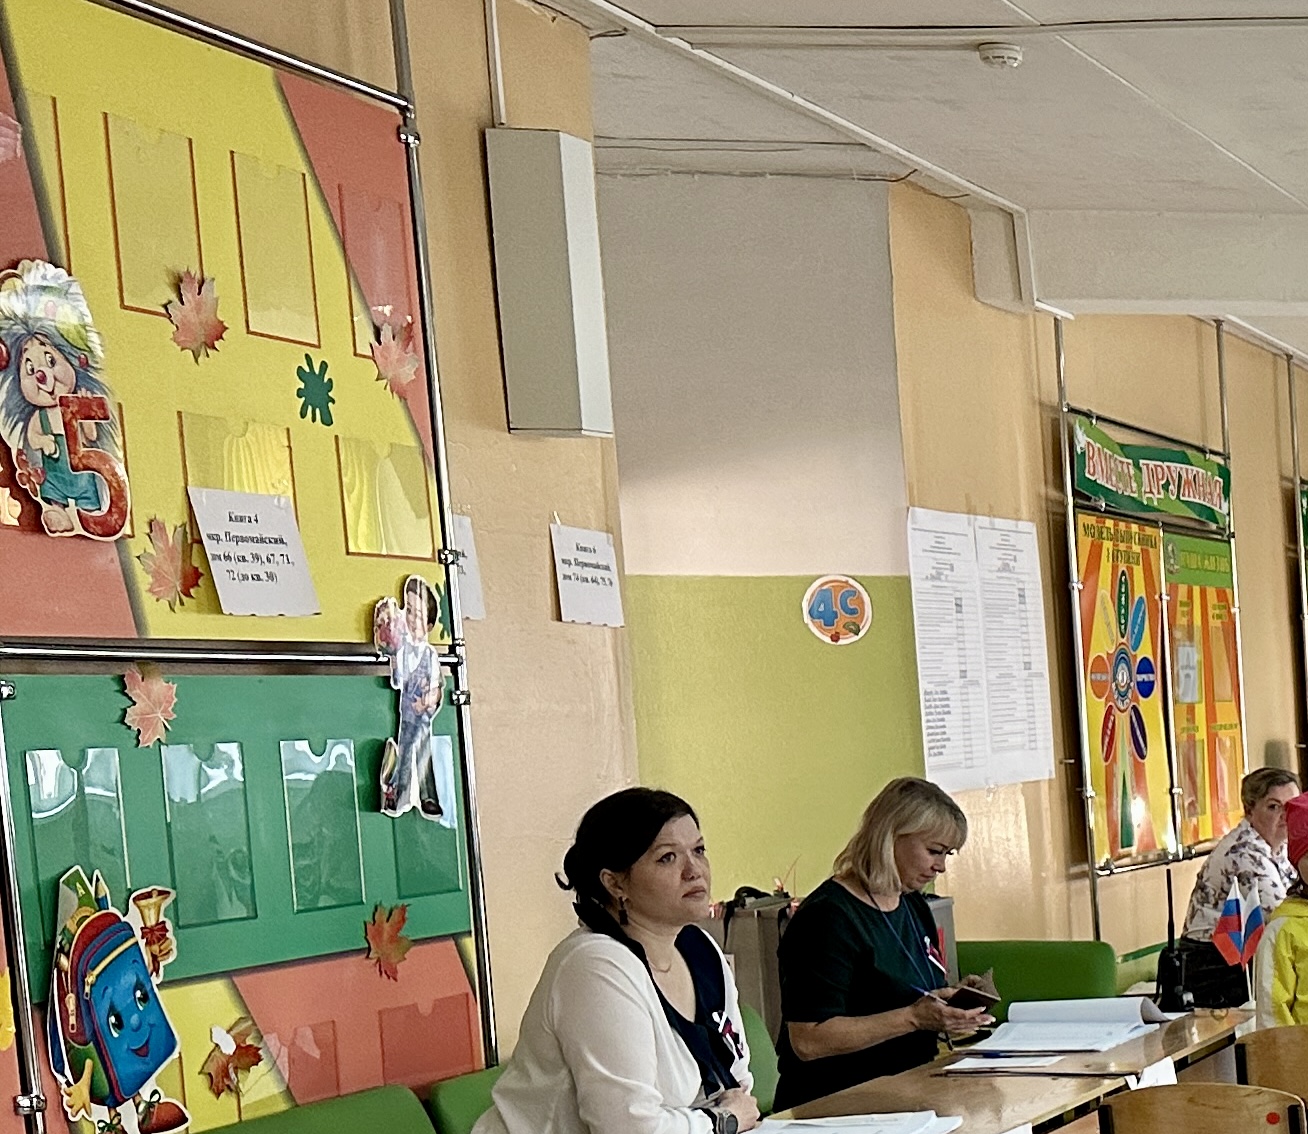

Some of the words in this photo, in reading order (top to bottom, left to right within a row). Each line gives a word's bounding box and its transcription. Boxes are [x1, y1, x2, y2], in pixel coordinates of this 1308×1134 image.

[59, 395, 128, 538] 5
[1139, 459, 1223, 512] ДРУЖНАЯ
[228, 511, 252, 524] Книга
[254, 513, 259, 524] 4
